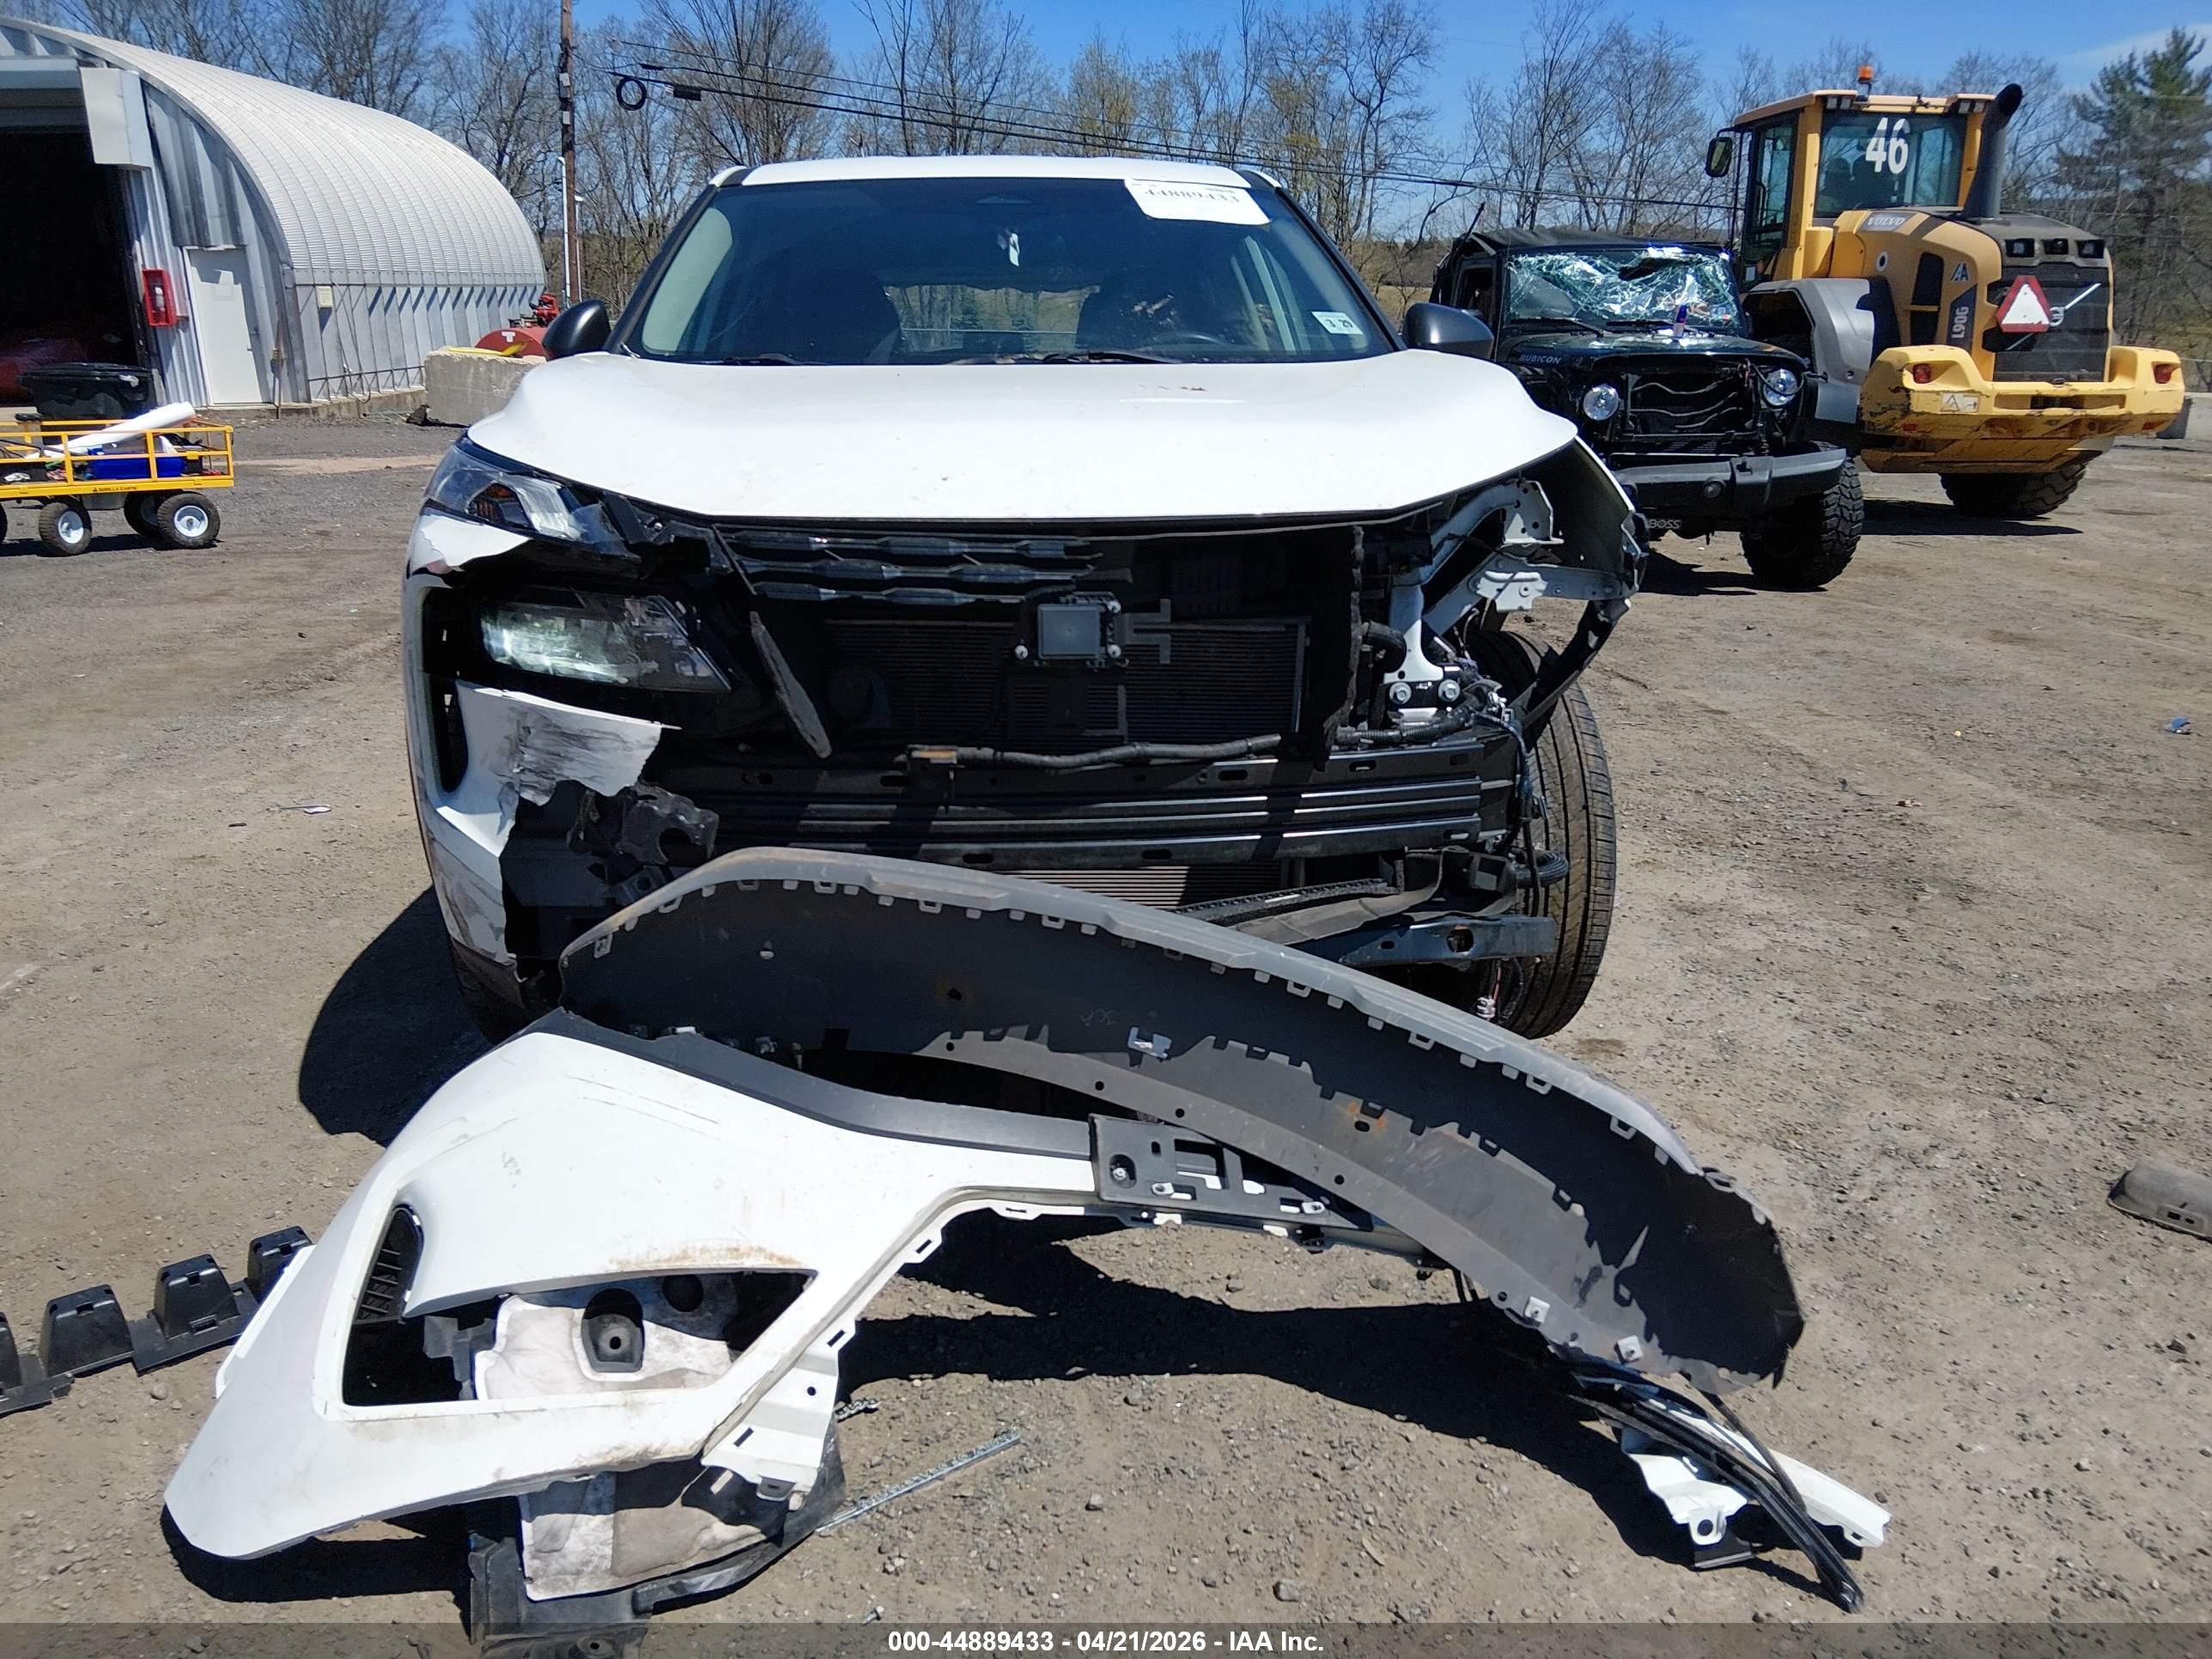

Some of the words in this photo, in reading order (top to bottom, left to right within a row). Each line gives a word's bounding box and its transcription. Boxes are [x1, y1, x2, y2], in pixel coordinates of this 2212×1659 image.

[1865, 117, 1911, 174] 46
[1867, 216, 1907, 226] VOLVO
[1951, 306, 1969, 338] L90G
[1519, 354, 1562, 364] RUBICON
[1648, 519, 1681, 529] BOSS
